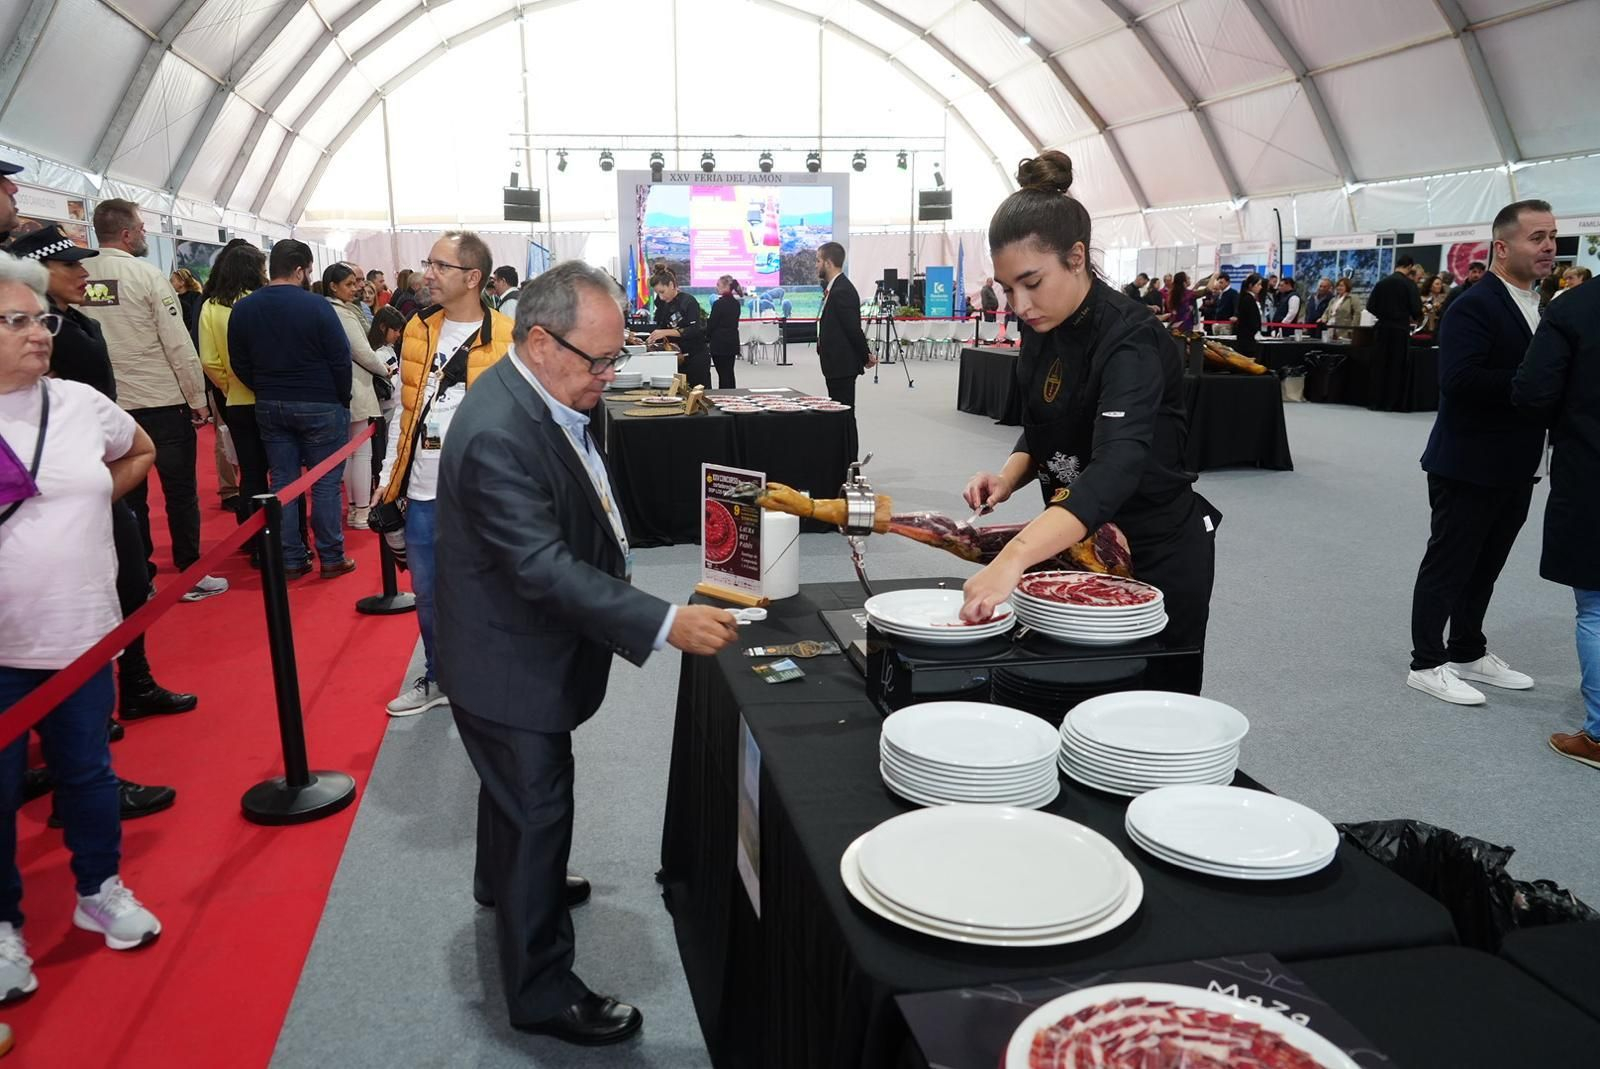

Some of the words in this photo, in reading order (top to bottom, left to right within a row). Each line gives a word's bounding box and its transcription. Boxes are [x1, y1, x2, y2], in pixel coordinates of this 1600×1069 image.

[670, 173, 690, 182] XXV
[694, 173, 723, 182] FERIA
[726, 173, 745, 182] DEL
[733, 504, 740, 516] 9
